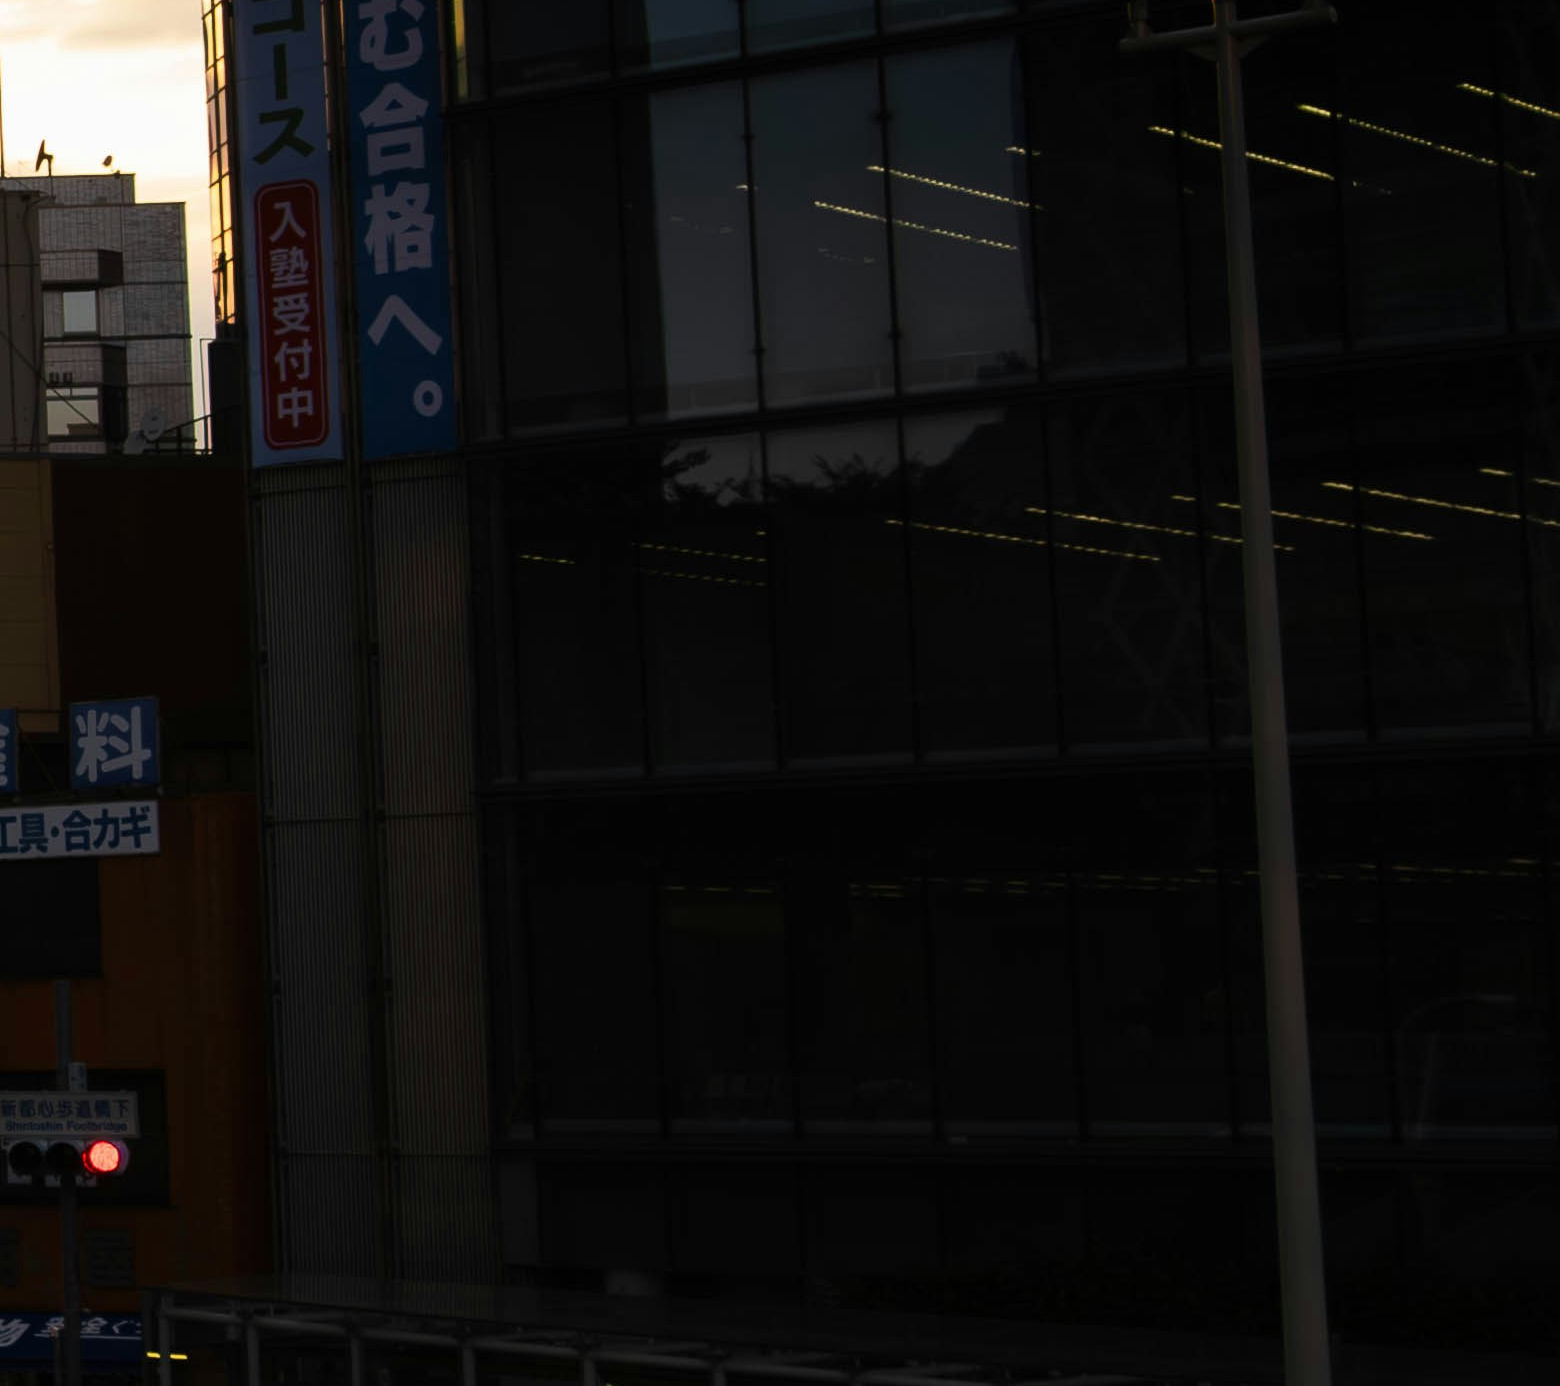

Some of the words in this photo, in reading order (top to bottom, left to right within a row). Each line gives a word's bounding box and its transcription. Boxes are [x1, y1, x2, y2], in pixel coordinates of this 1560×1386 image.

[265, 198, 316, 431] 入塾受付中
